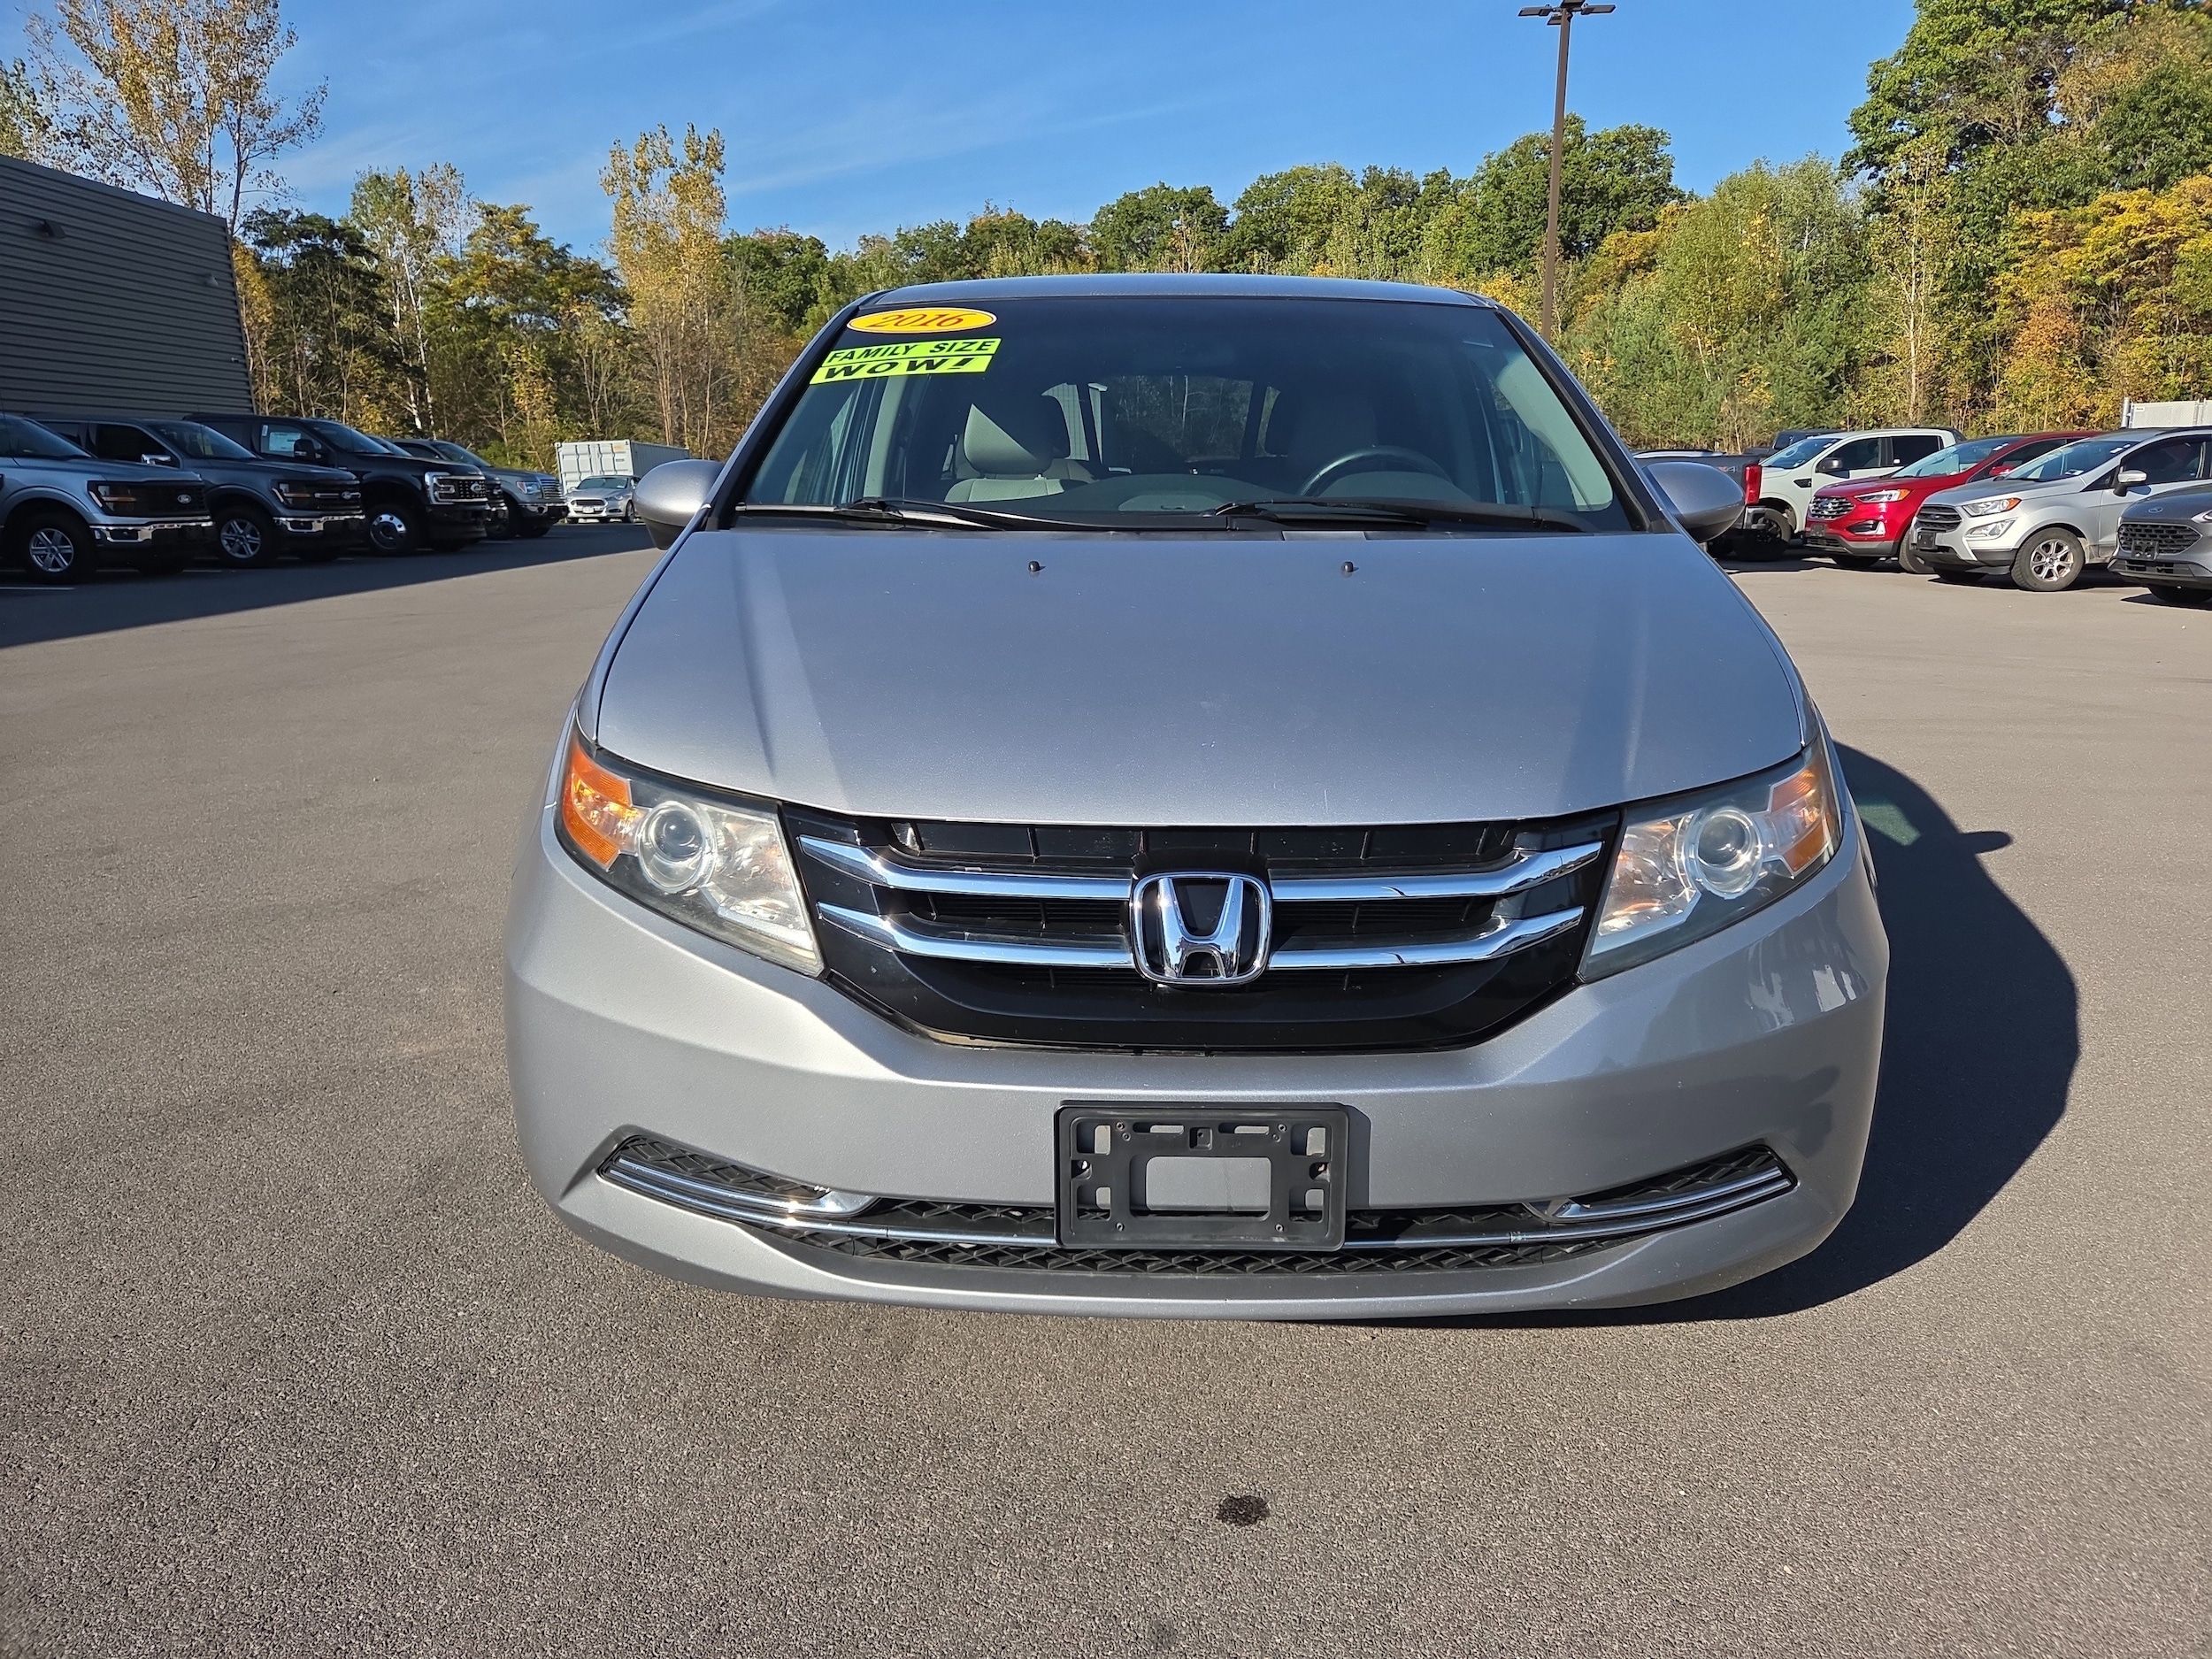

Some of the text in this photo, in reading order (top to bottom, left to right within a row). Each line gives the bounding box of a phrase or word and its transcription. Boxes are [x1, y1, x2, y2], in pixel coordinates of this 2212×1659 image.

[865, 312, 977, 328] 2016
[826, 341, 996, 363] FAMILY SIZE
[825, 357, 975, 380] WOW!
